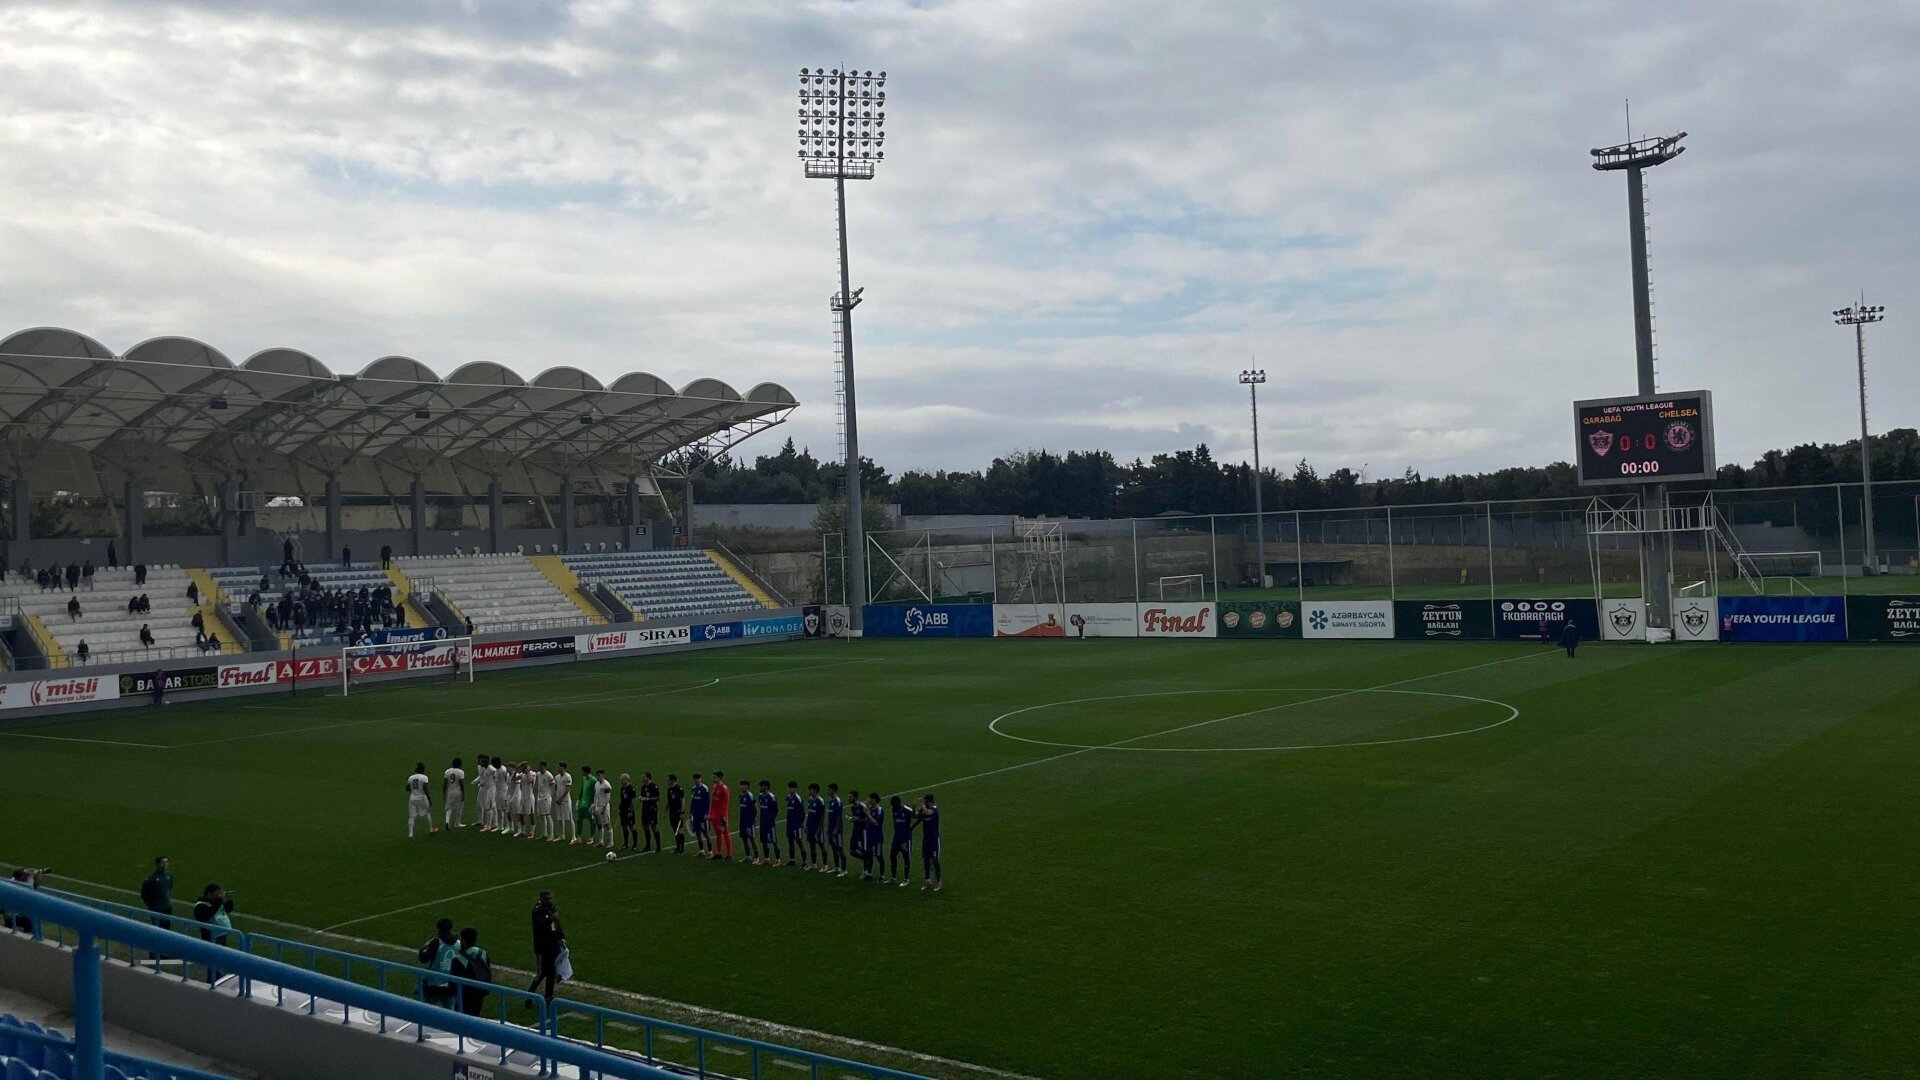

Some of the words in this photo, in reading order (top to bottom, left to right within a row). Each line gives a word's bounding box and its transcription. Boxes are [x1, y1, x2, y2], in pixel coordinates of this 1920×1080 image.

[1604, 406, 1621, 414] UEFA
[1622, 404, 1645, 413] YOUTH
[1646, 402, 1674, 410] LEAGUE
[1659, 408, 1698, 419] CHELSEA
[1619, 434, 1631, 452] 0
[1644, 433, 1657, 450] 0
[1621, 460, 1659, 475] 00:00
[925, 612, 949, 625] ABB
[1143, 607, 1210, 633] Final
[1422, 611, 1462, 621] ZEYTUN
[1753, 614, 1791, 624] YOUTH
[1793, 613, 1836, 624] LEAGUE
[717, 625, 731, 635] ABB
[760, 625, 785, 635] BONA
[523, 641, 557, 652] FERRO
[596, 632, 628, 647] misli
[484, 644, 522, 659] MARKET
[220, 663, 275, 687] Final
[46, 678, 99, 696] misli
[136, 673, 217, 692] BAARSTORE
